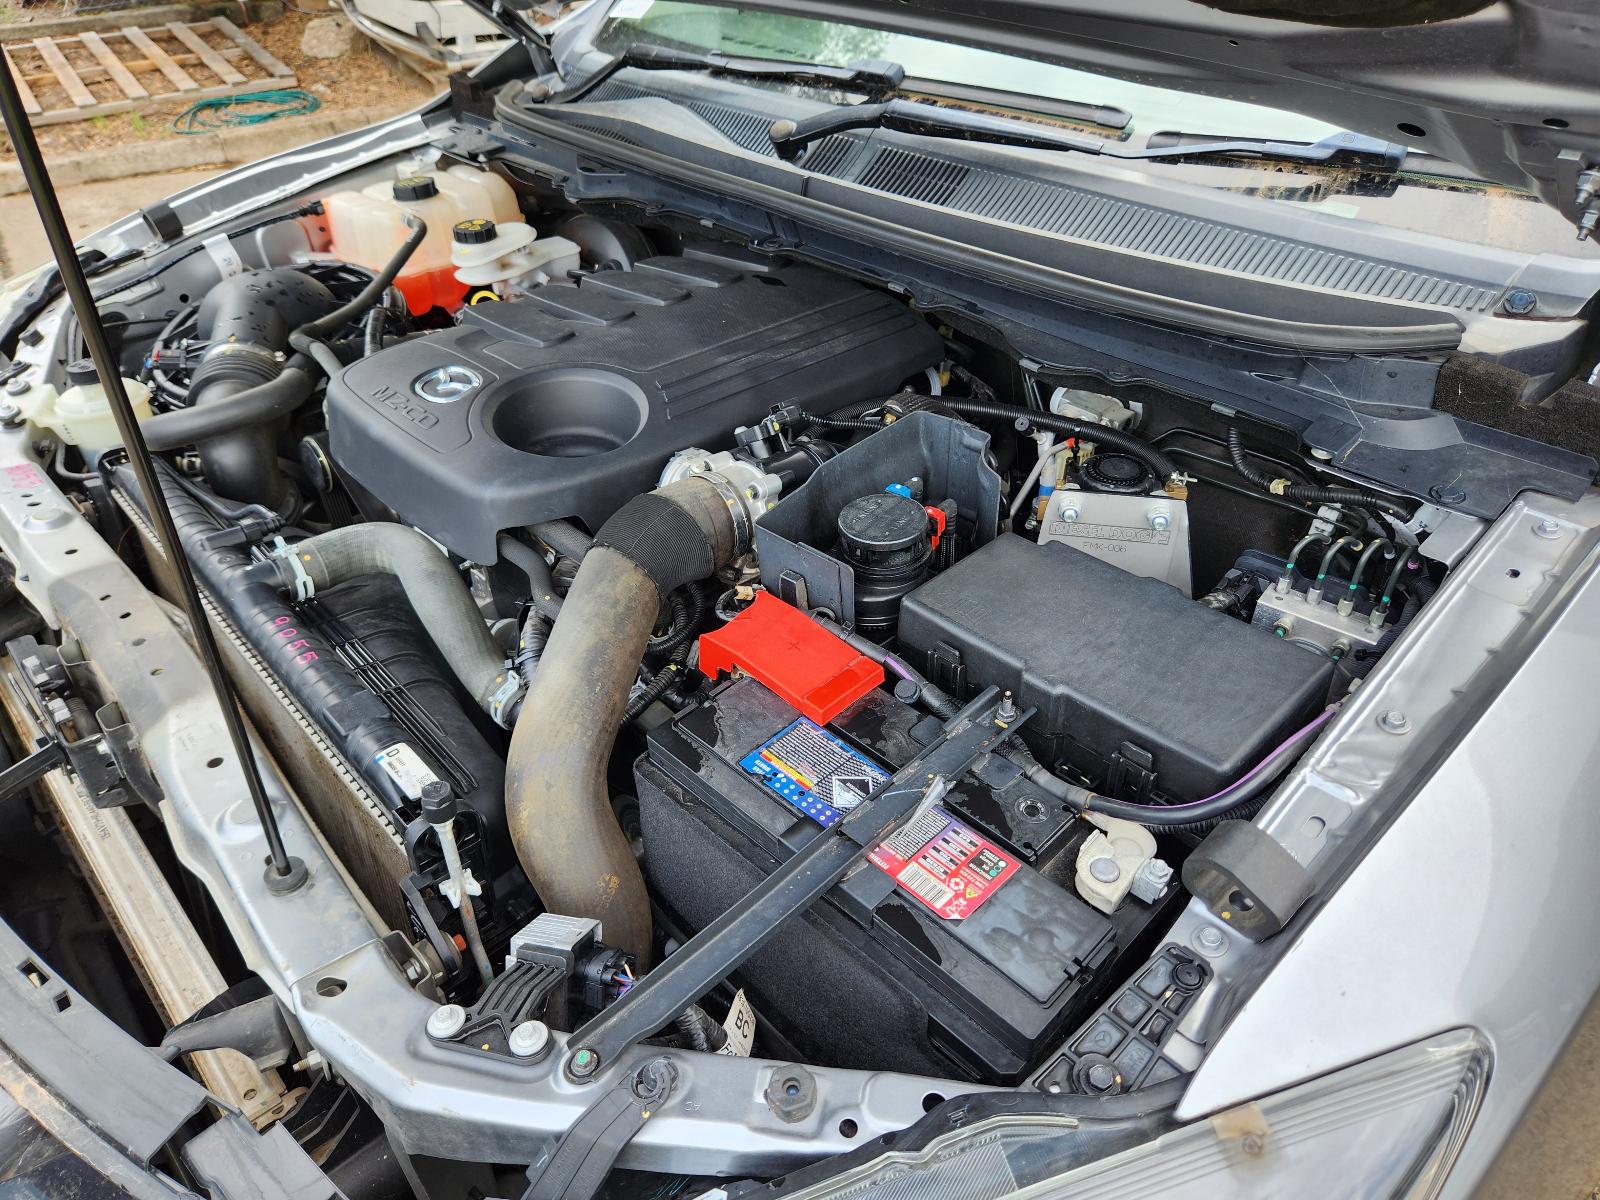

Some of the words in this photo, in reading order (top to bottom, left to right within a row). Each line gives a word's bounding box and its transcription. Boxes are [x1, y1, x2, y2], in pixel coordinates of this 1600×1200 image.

[1051, 522, 1104, 538] DIESEL
[271, 615, 319, 665] 9055
[385, 748, 400, 758] D
[735, 1009, 749, 1039] BC
